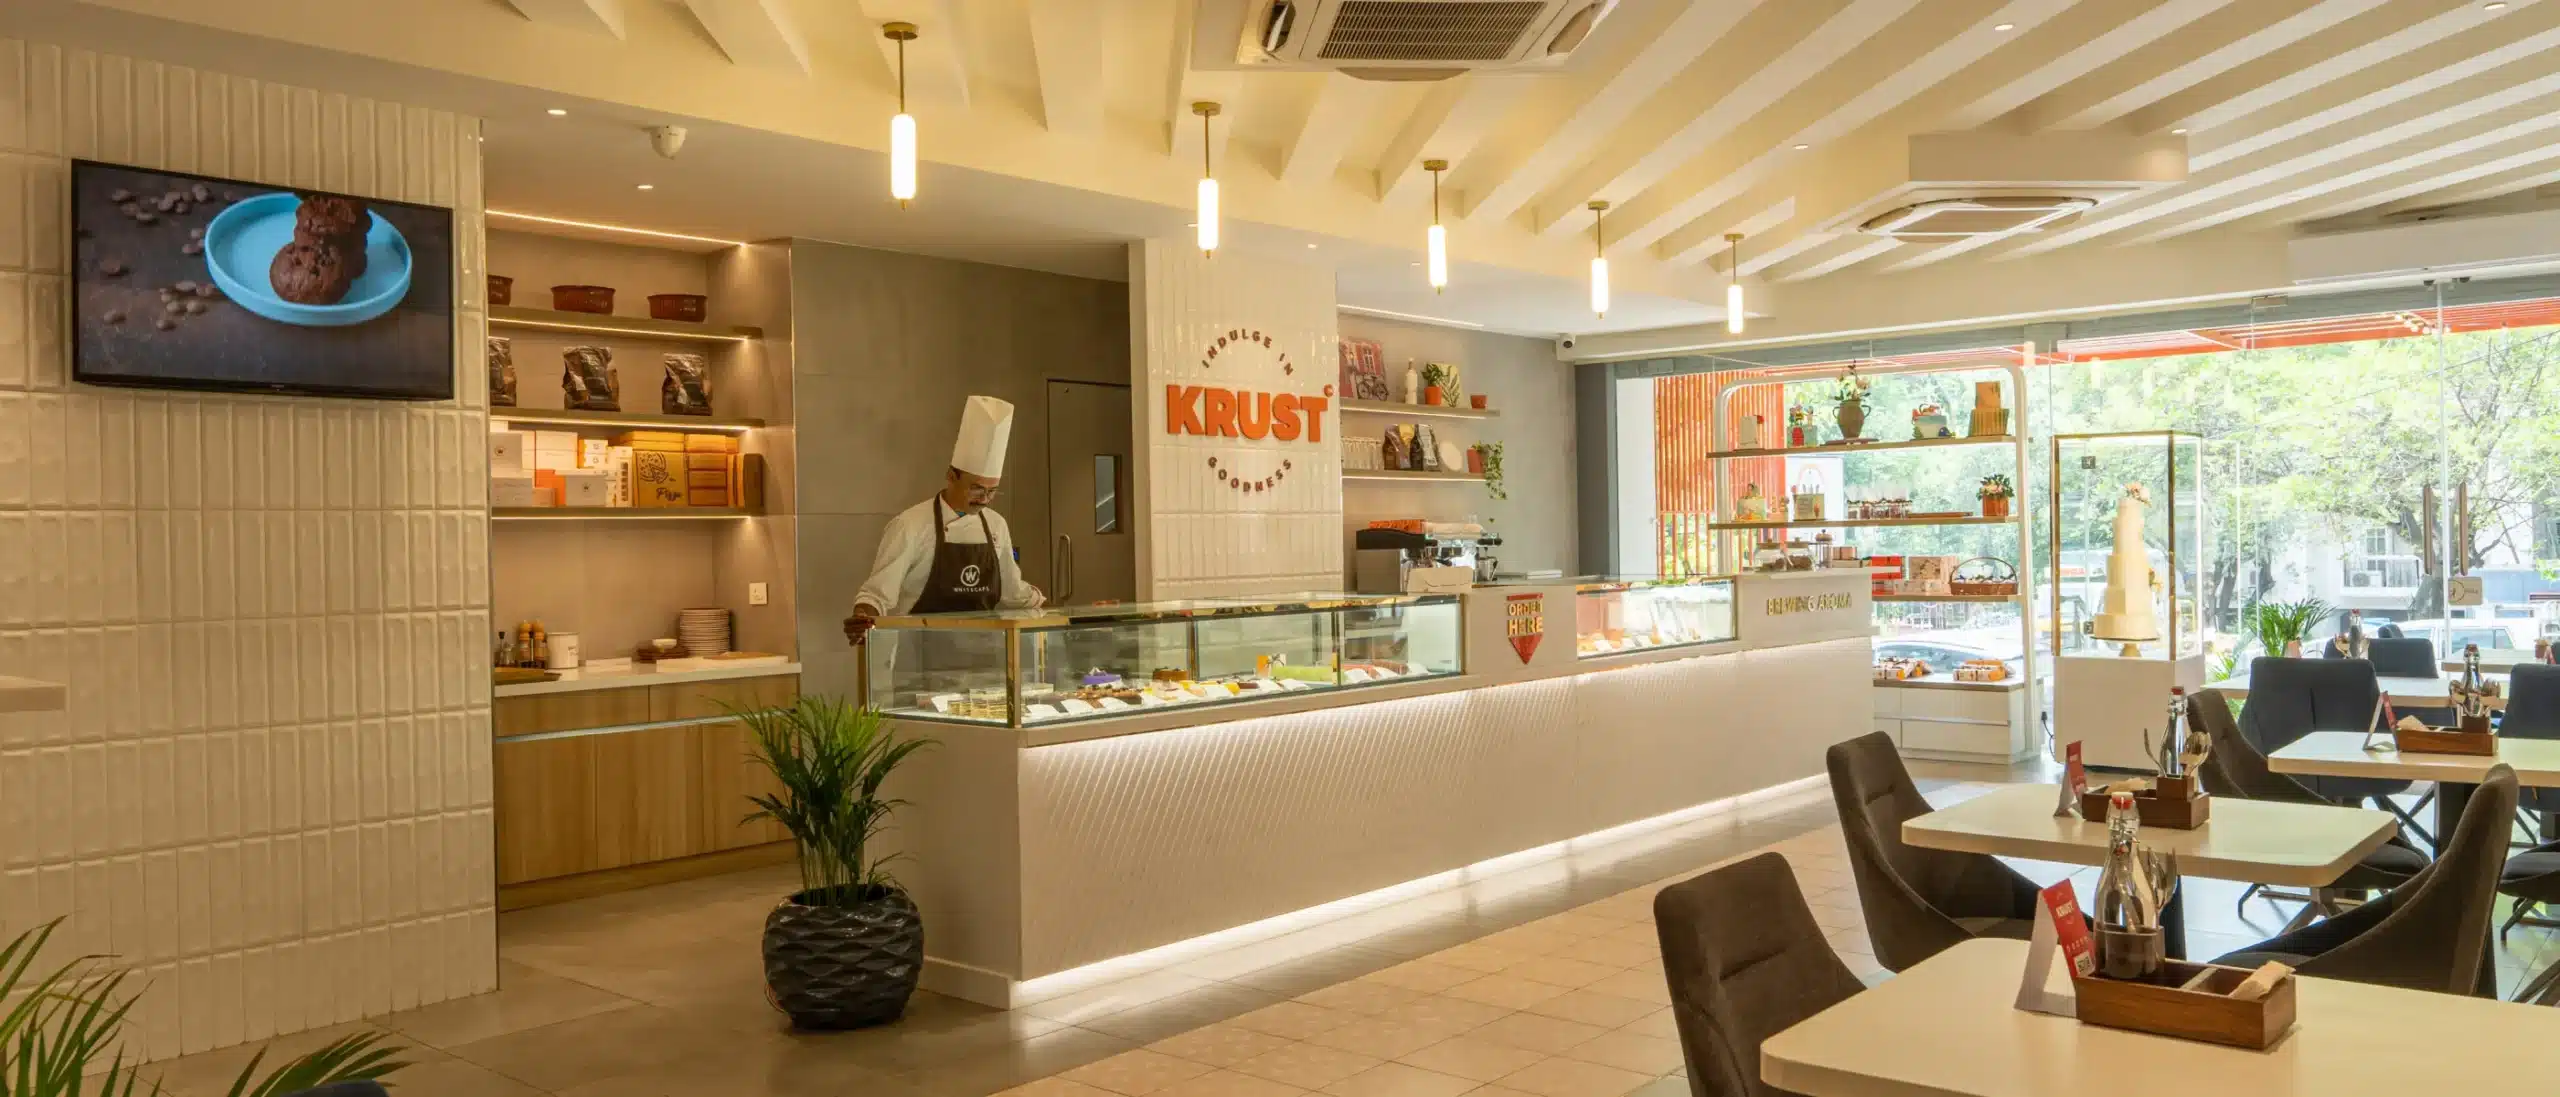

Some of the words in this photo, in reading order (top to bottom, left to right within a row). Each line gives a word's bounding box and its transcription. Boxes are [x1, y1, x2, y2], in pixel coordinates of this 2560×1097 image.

[1202, 328, 1273, 368] INDULGE
[1279, 353, 1294, 376] IN
[1166, 384, 1329, 443] KRUST
[1207, 456, 1292, 493] GOODNESS
[1508, 600, 1543, 616] ORDER
[1767, 596, 1816, 616] BREWING
[1817, 592, 1852, 611] AROMA
[1508, 616, 1544, 636] HERE
